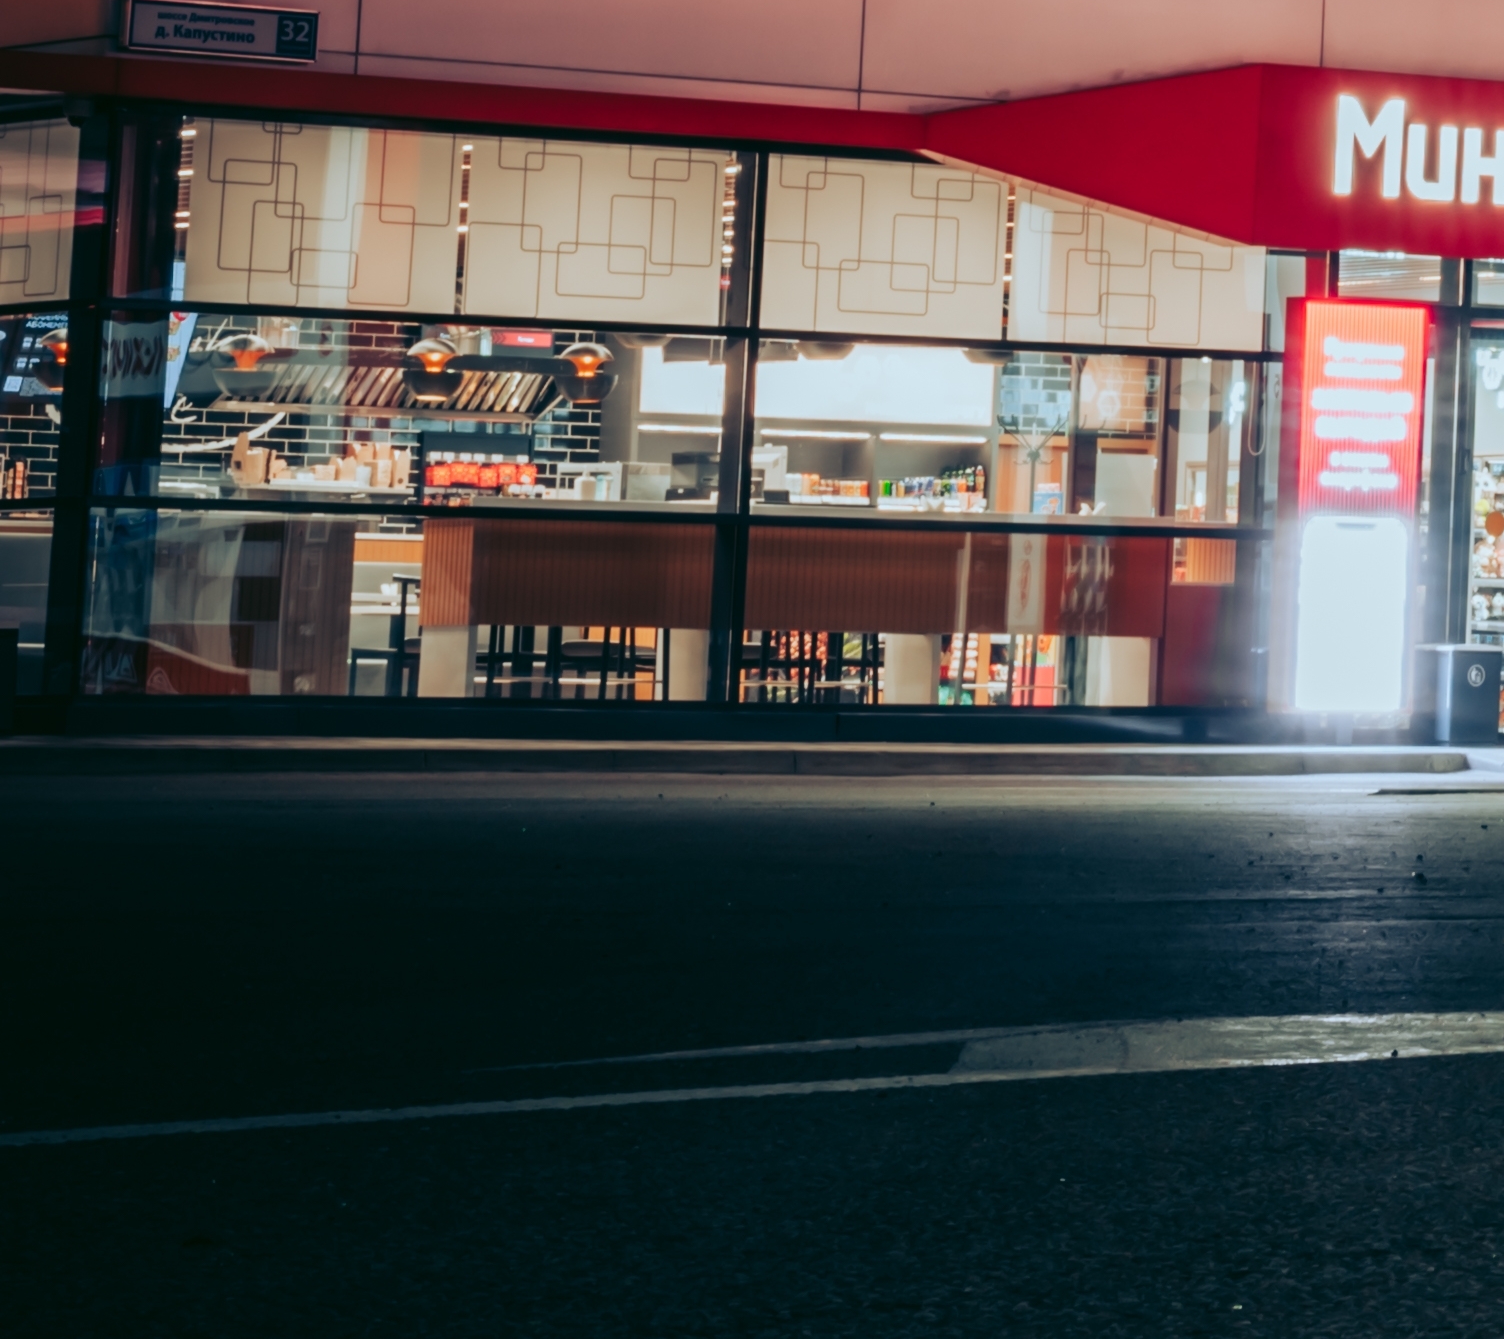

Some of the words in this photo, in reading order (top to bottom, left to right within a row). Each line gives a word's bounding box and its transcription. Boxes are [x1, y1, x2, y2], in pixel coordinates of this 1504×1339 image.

[155, 24, 170, 40] д.
[173, 24, 255, 44] Капустино
[280, 20, 310, 42] 32
